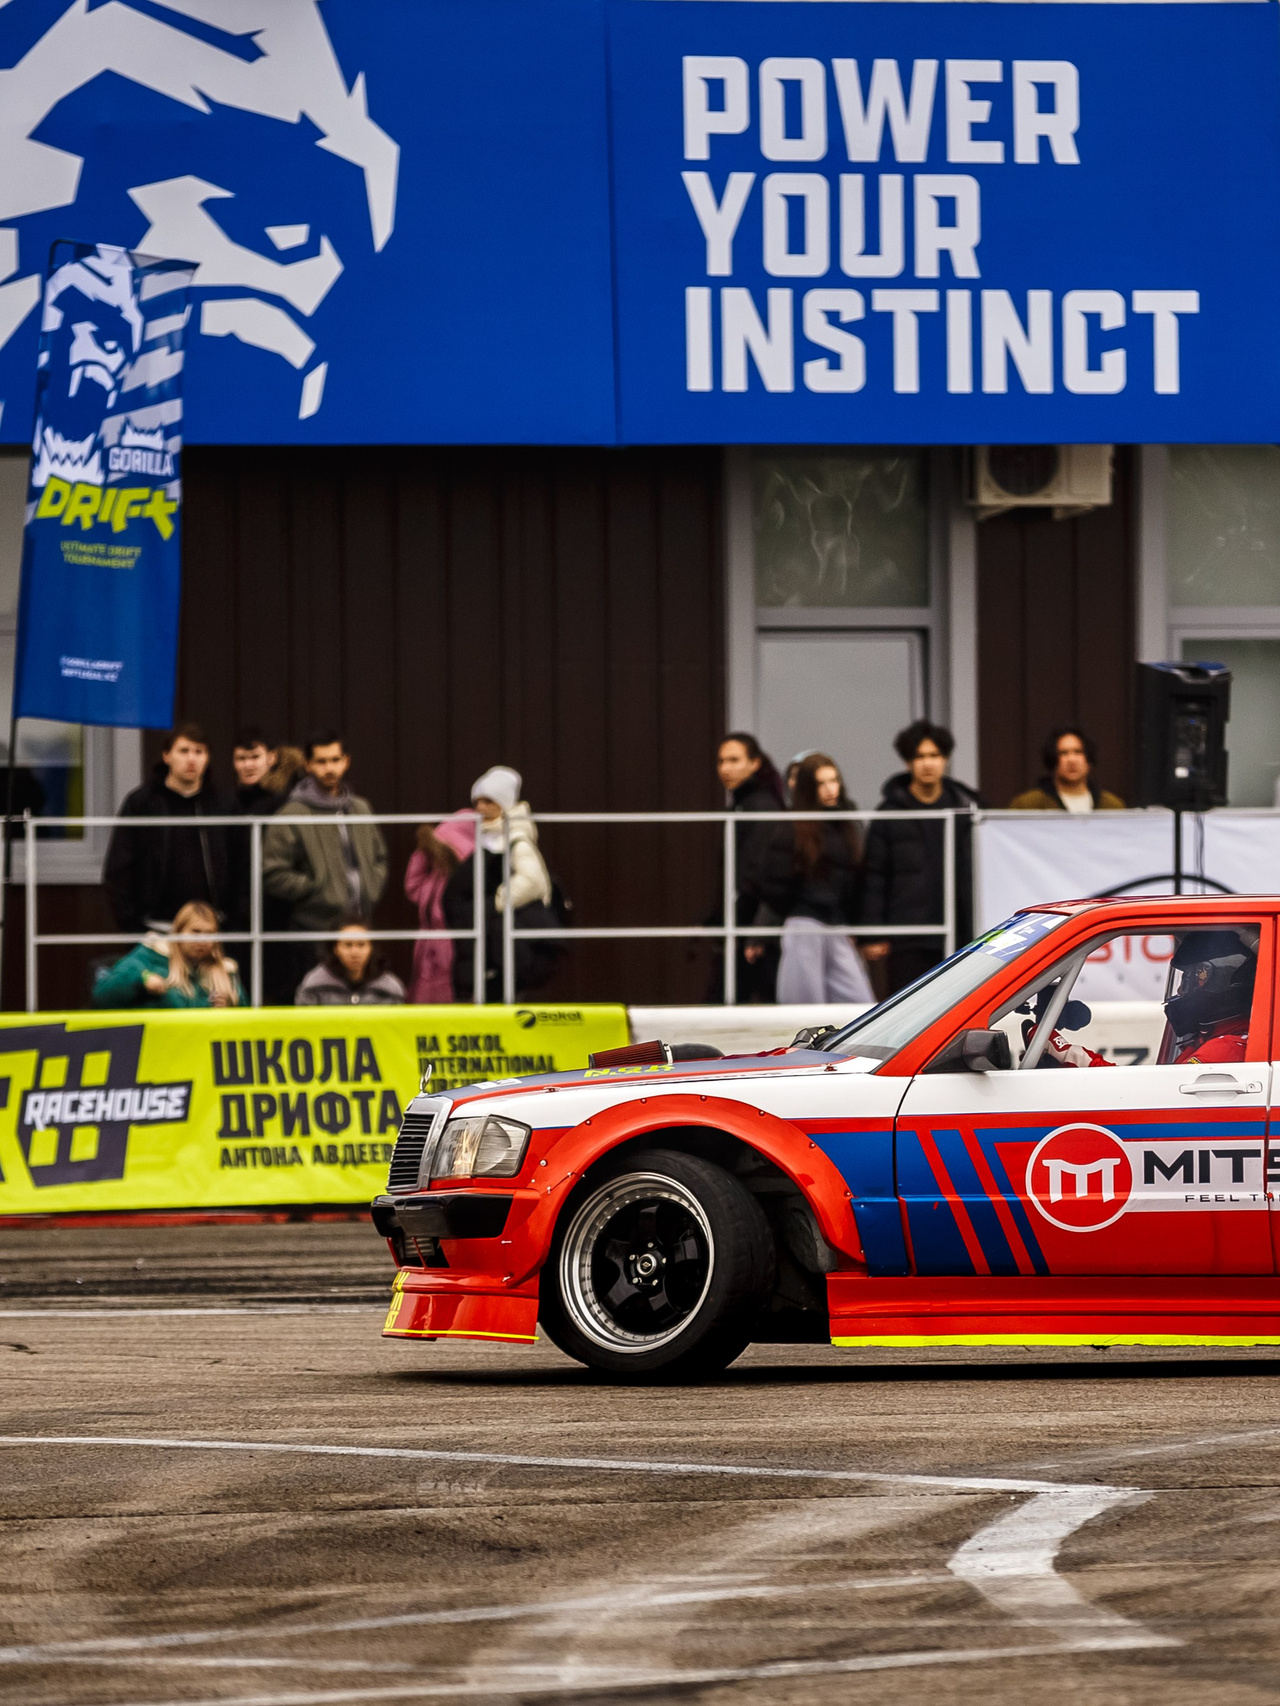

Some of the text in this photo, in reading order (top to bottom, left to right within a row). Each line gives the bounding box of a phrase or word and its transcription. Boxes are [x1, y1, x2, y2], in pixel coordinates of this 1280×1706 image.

[682, 55, 1081, 165] POWER
[681, 171, 982, 279] YOUR
[684, 286, 1200, 395] INSTINCT
[108, 446, 175, 477] GORILLA
[35, 475, 179, 541] DRIFT
[211, 1037, 383, 1086] ШКОЛА
[419, 1054, 558, 1074] INTERNATIONAL
[447, 1034, 504, 1053] SOKOL
[24, 1085, 188, 1132] RACEHOUSE
[217, 1089, 404, 1139] ДРИФТА
[220, 1145, 304, 1169] АНТОНА
[1184, 1194, 1241, 1203] FEEL
